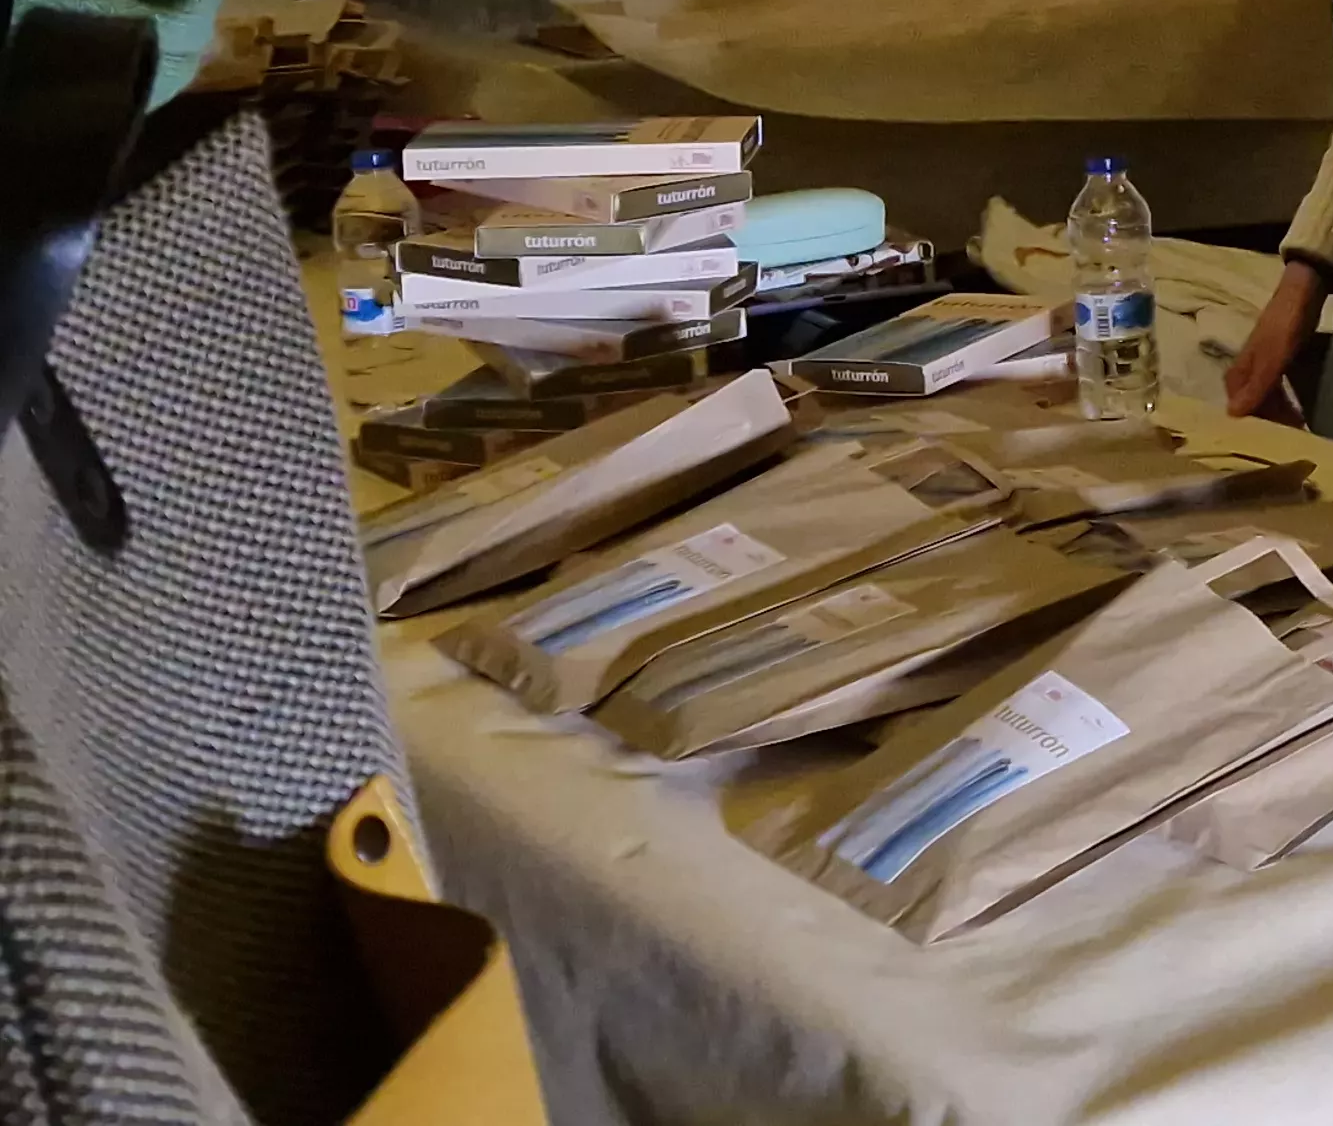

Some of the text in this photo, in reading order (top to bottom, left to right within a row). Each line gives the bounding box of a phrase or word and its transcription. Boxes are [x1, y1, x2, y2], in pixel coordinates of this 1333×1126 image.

[657, 184, 716, 205] tuturrón
[524, 234, 597, 249] tuturrón
[831, 368, 889, 384] tuturrón
[994, 704, 1070, 759] tuturrón
